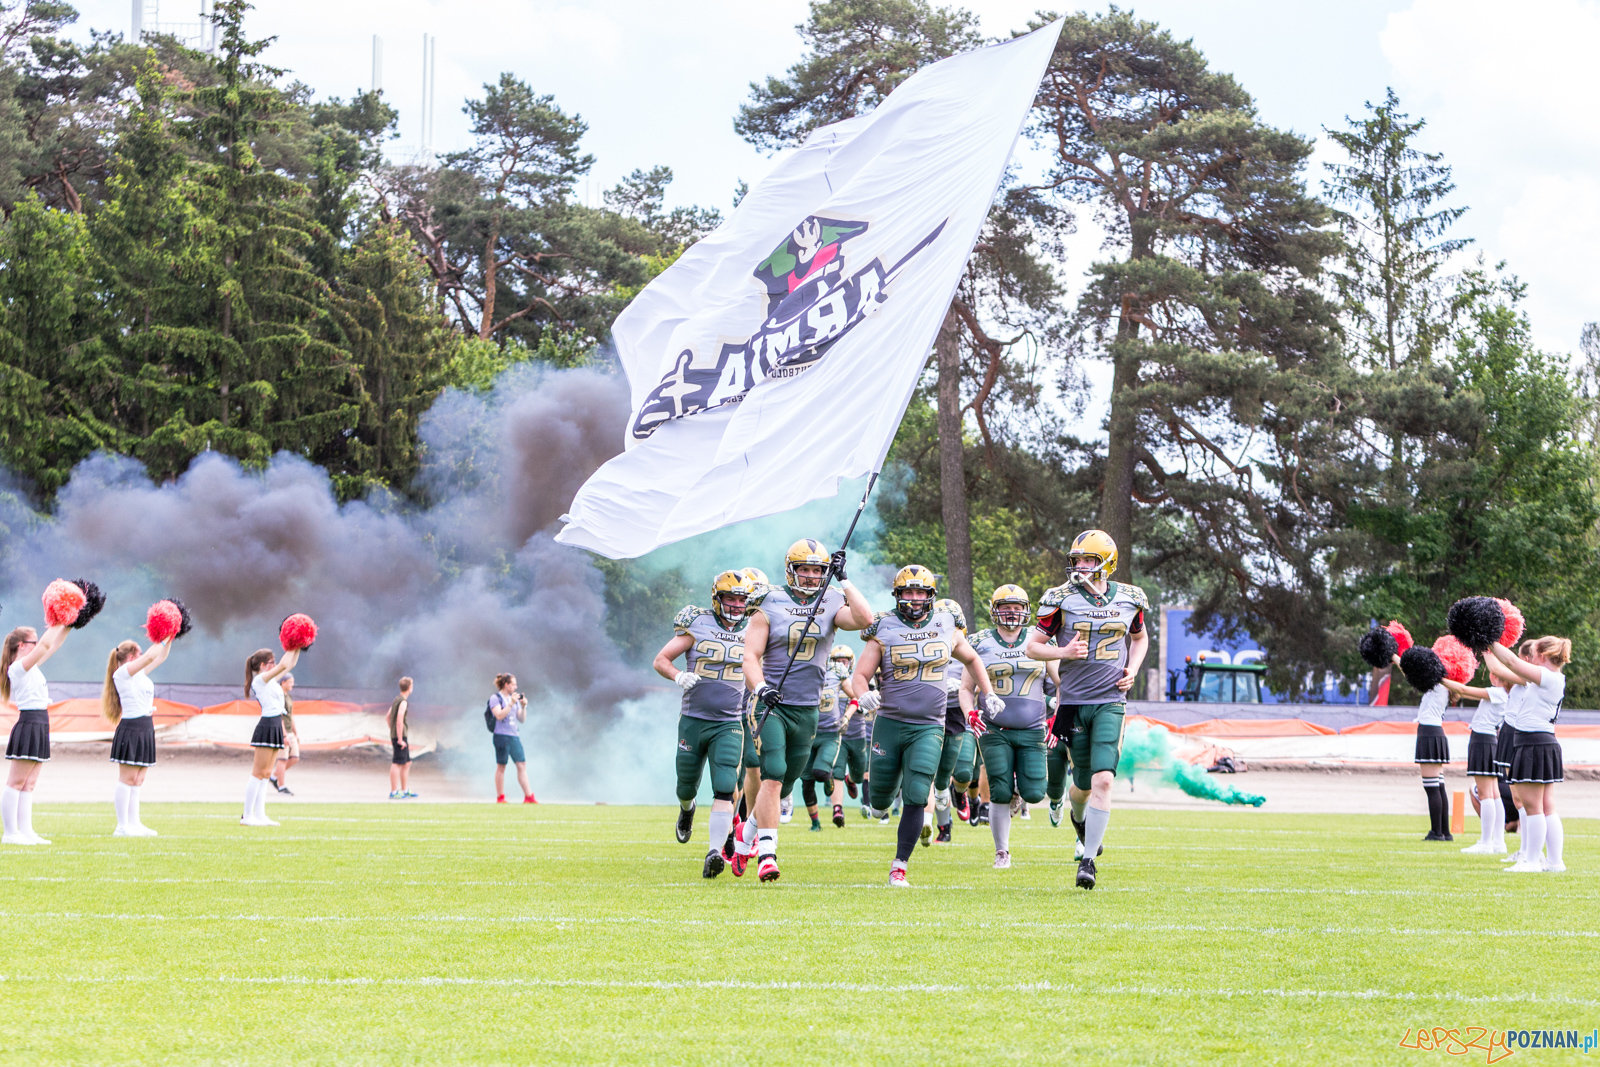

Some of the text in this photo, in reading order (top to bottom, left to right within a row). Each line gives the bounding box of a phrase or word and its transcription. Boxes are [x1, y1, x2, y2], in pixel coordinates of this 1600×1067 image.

[715, 632, 740, 642] ARMIA
[787, 620, 821, 661] 6
[905, 632, 930, 640] ARMIA
[1000, 650, 1026, 659] ARMIA
[1072, 621, 1127, 661] 12
[694, 639, 745, 681] 22
[890, 641, 949, 682] 52
[986, 661, 1044, 696] 87
